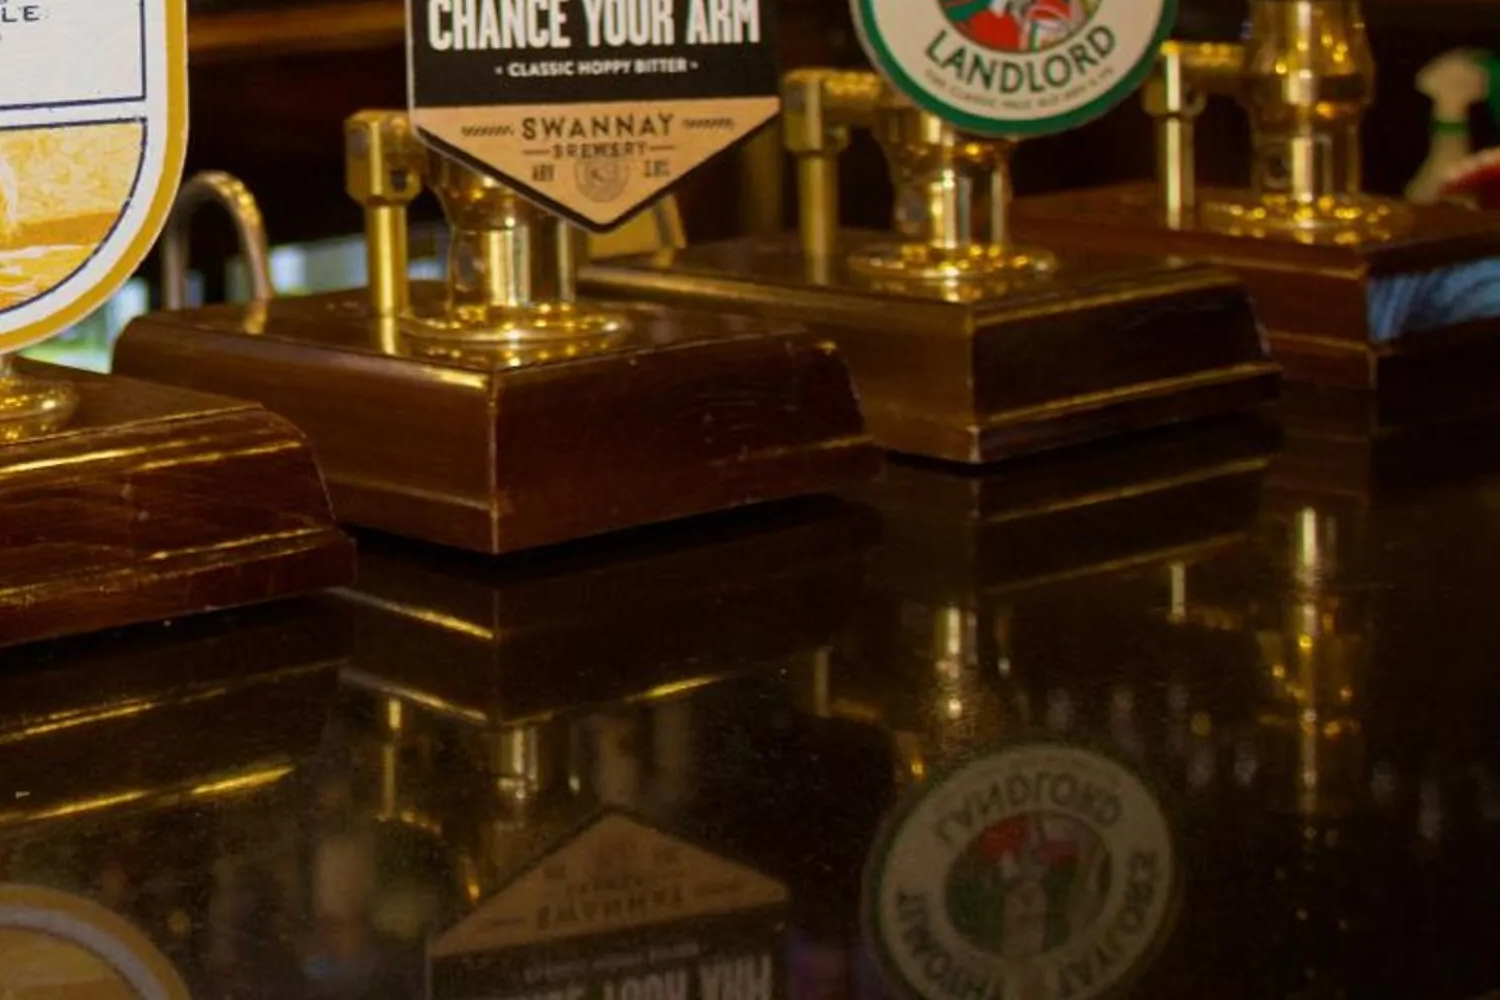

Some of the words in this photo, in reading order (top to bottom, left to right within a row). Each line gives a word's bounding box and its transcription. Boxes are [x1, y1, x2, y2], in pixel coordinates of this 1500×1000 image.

[508, 61, 573, 77] CLASSIC
[577, 60, 631, 76] HOPPY
[634, 58, 687, 74] BITTER
[924, 24, 1117, 95] LANDLORD
[521, 113, 675, 141] SWANNAY
[551, 141, 646, 160] BREWERY
